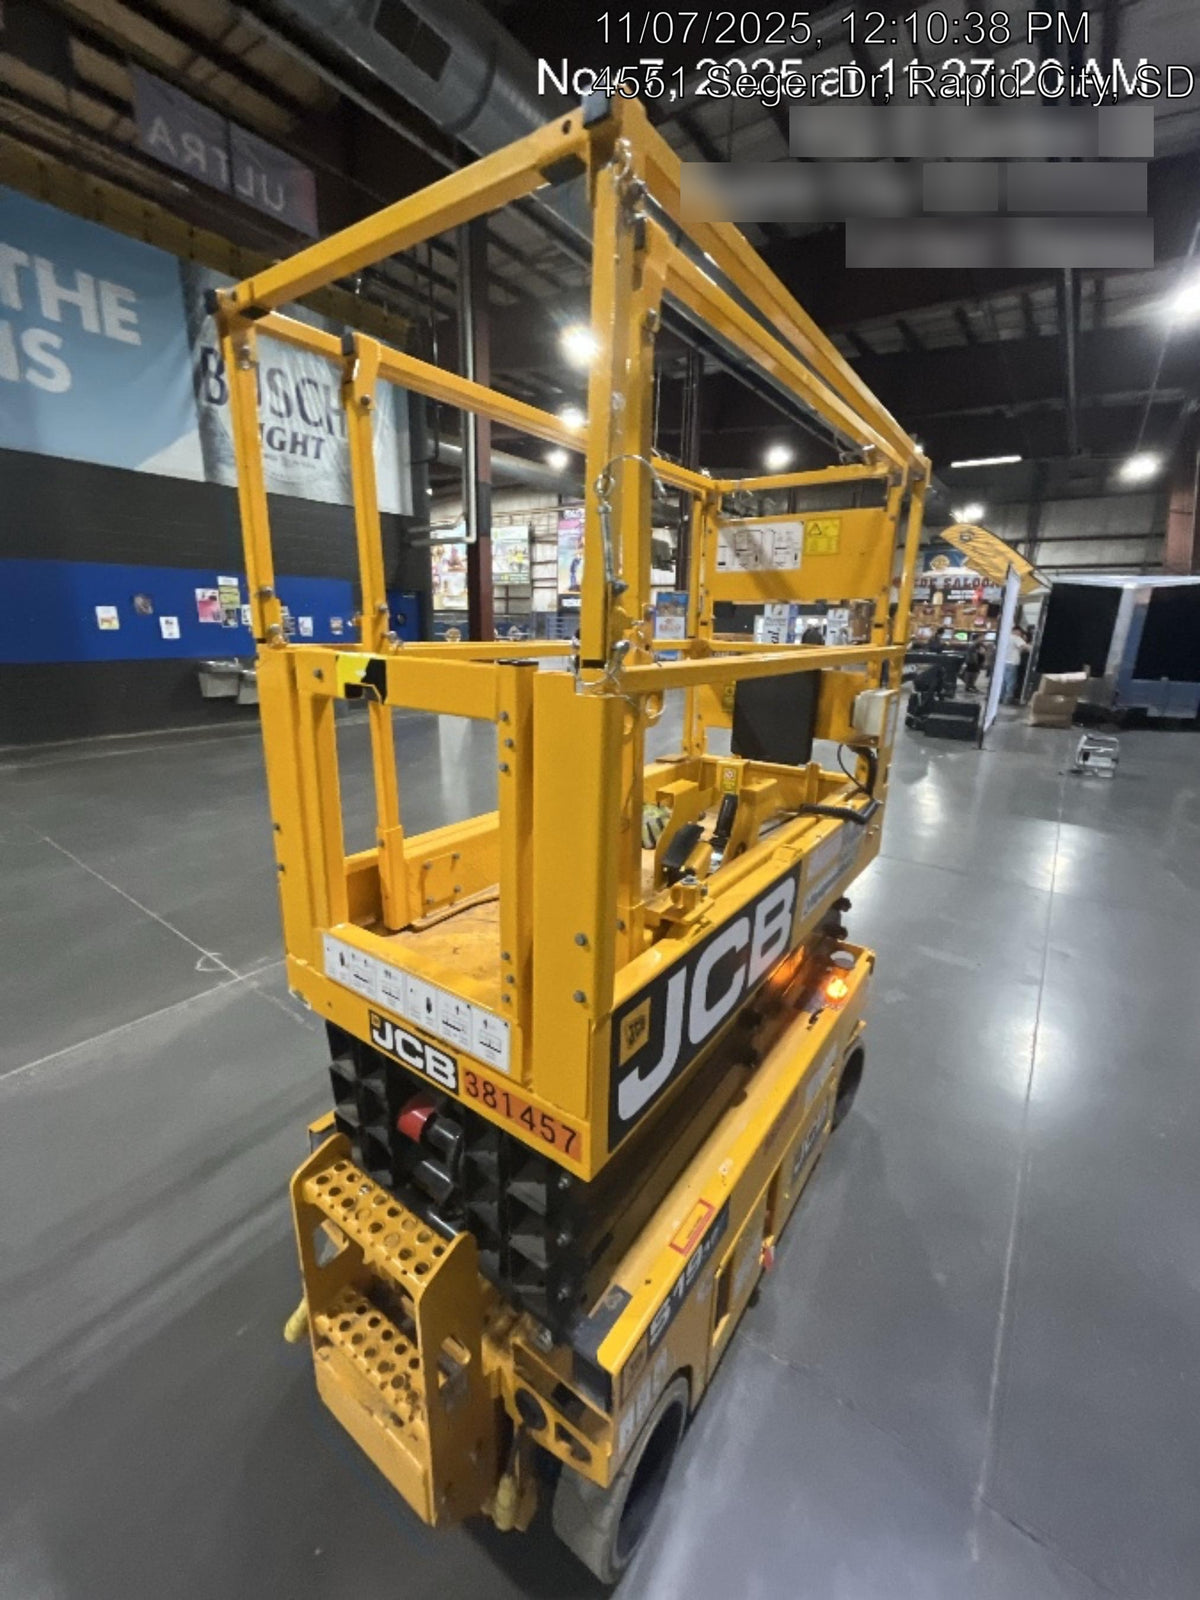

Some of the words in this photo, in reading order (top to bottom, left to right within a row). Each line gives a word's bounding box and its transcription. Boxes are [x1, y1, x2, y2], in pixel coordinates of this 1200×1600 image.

[0, 242, 142, 346] THE
[199, 346, 346, 437] BSCH
[617, 877, 796, 1121] JCB
[372, 1021, 457, 1090] JCB
[465, 1071, 578, 1154] 381457
